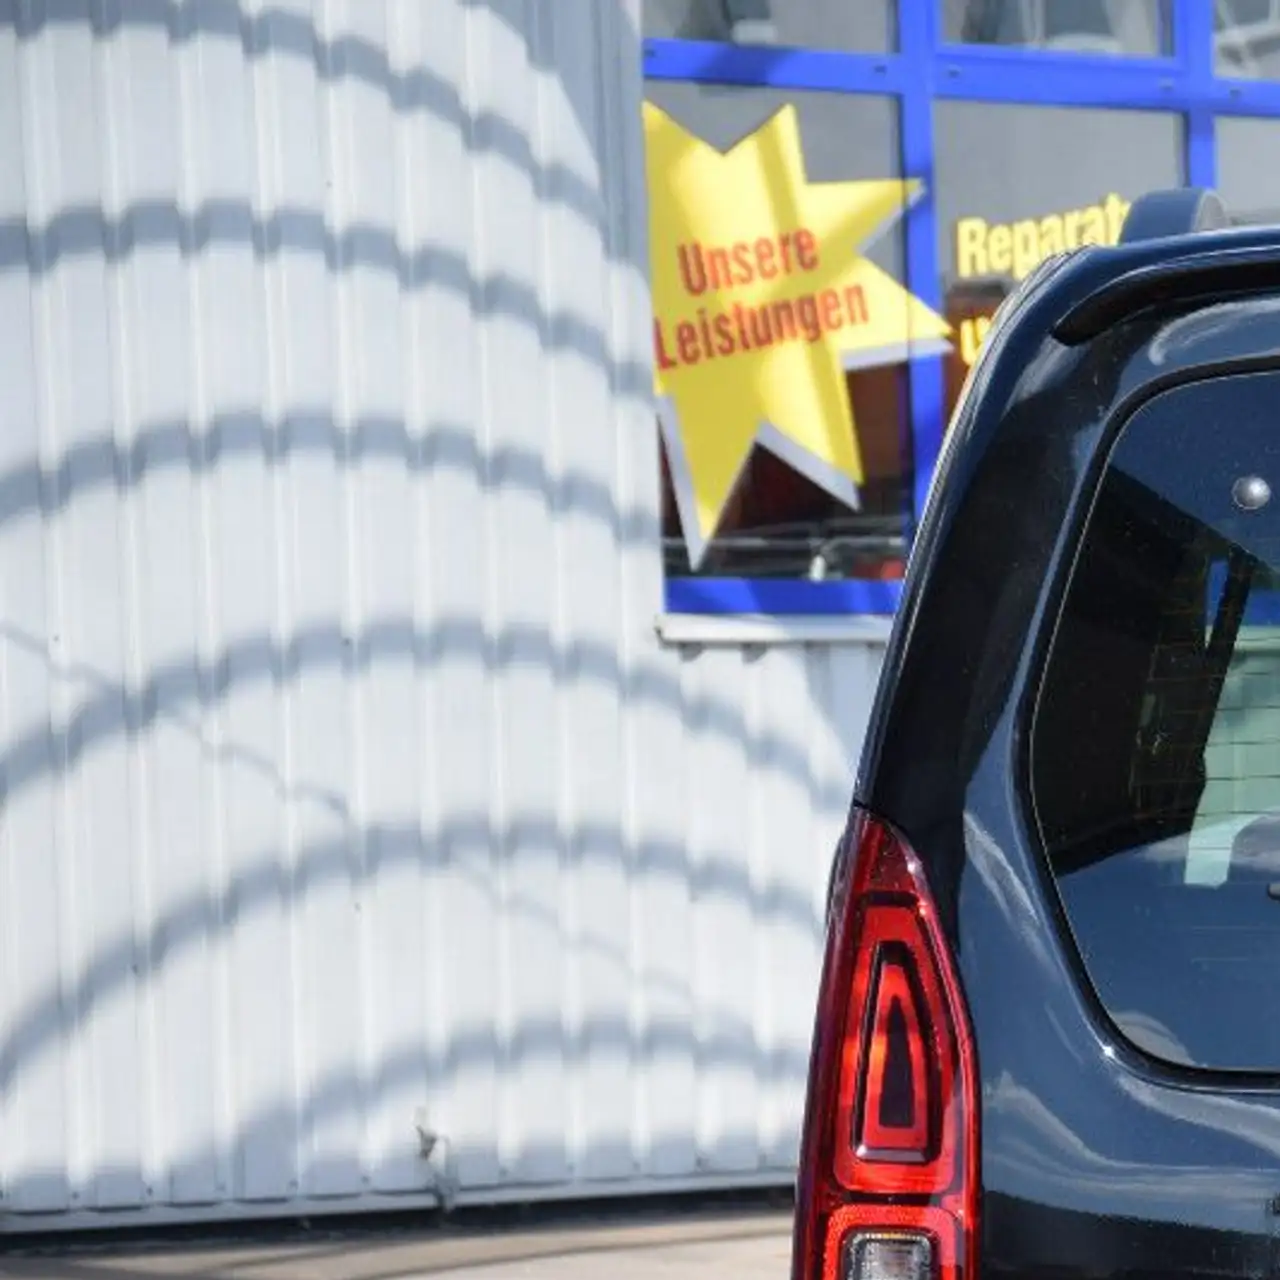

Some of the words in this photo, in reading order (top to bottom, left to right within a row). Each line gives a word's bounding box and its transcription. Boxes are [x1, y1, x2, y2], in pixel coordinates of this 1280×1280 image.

[677, 227, 819, 297] Unsere
[957, 192, 1132, 281] Reparat
[653, 283, 869, 370] Leistungen
